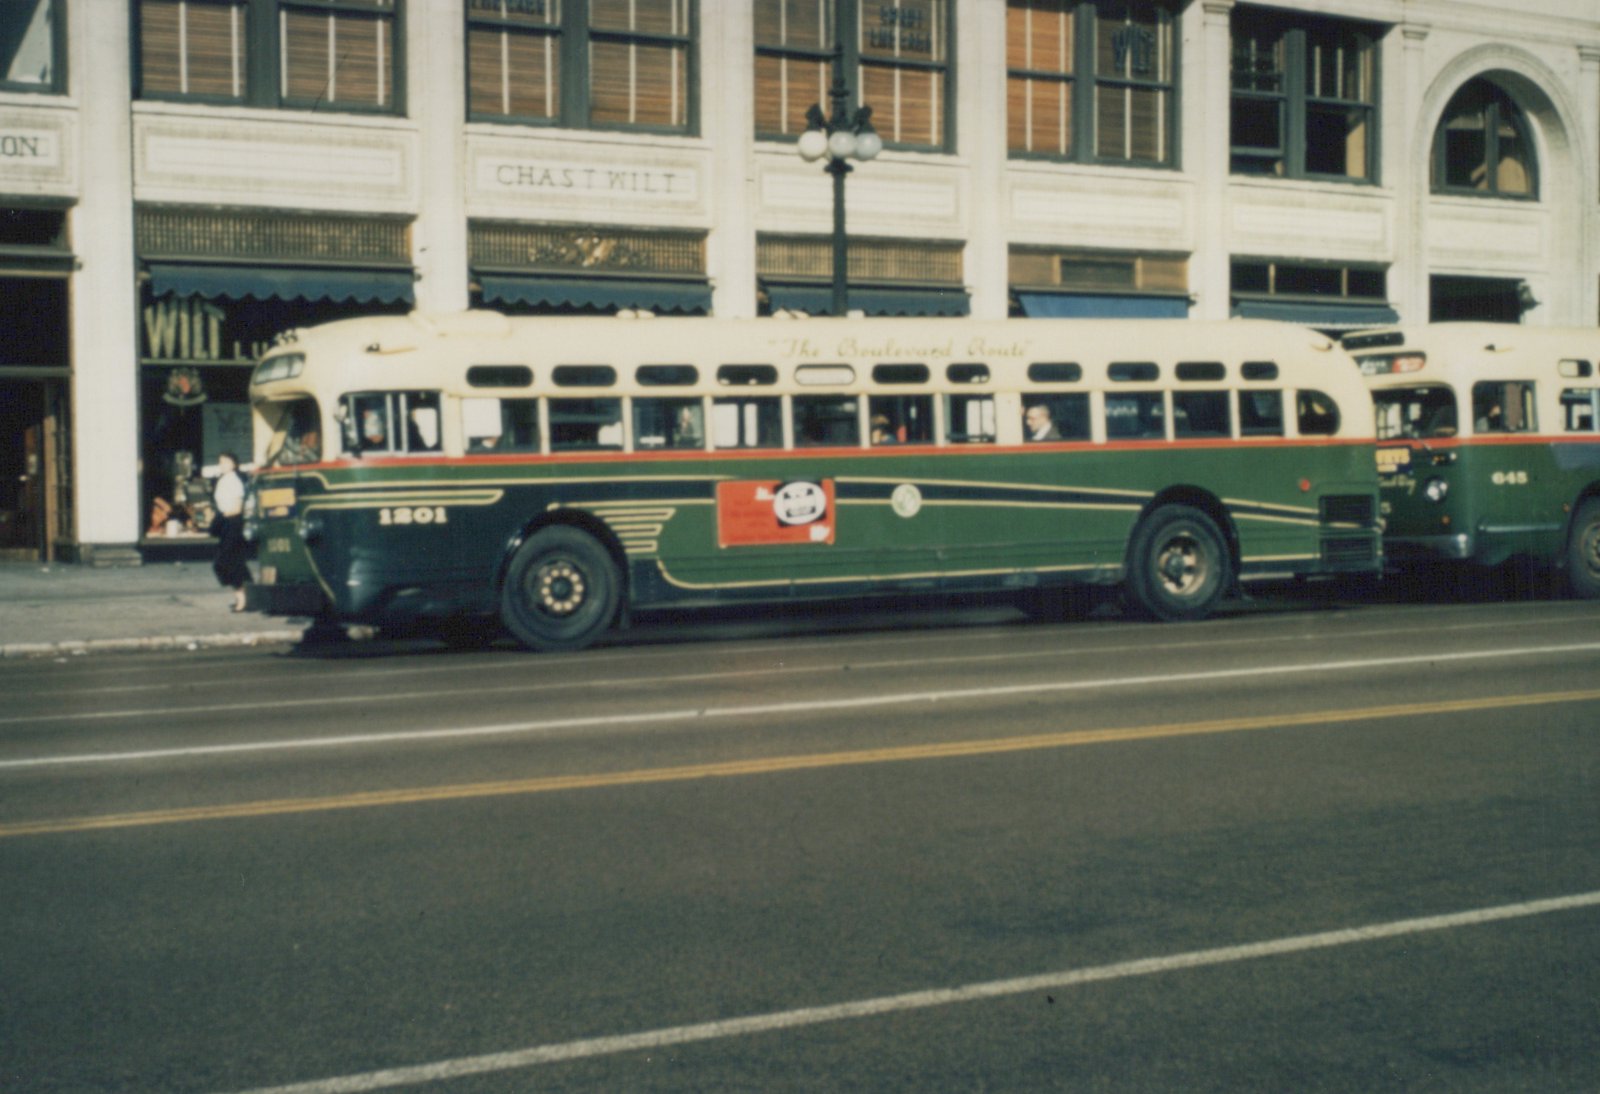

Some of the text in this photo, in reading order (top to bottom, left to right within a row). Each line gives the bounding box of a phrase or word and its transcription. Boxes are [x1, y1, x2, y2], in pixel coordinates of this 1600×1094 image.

[496, 164, 574, 188] CHAS
[607, 170, 676, 194] WILT
[144, 298, 226, 361] WILT
[837, 337, 952, 359] Boulevard
[379, 506, 447, 526] 1201
